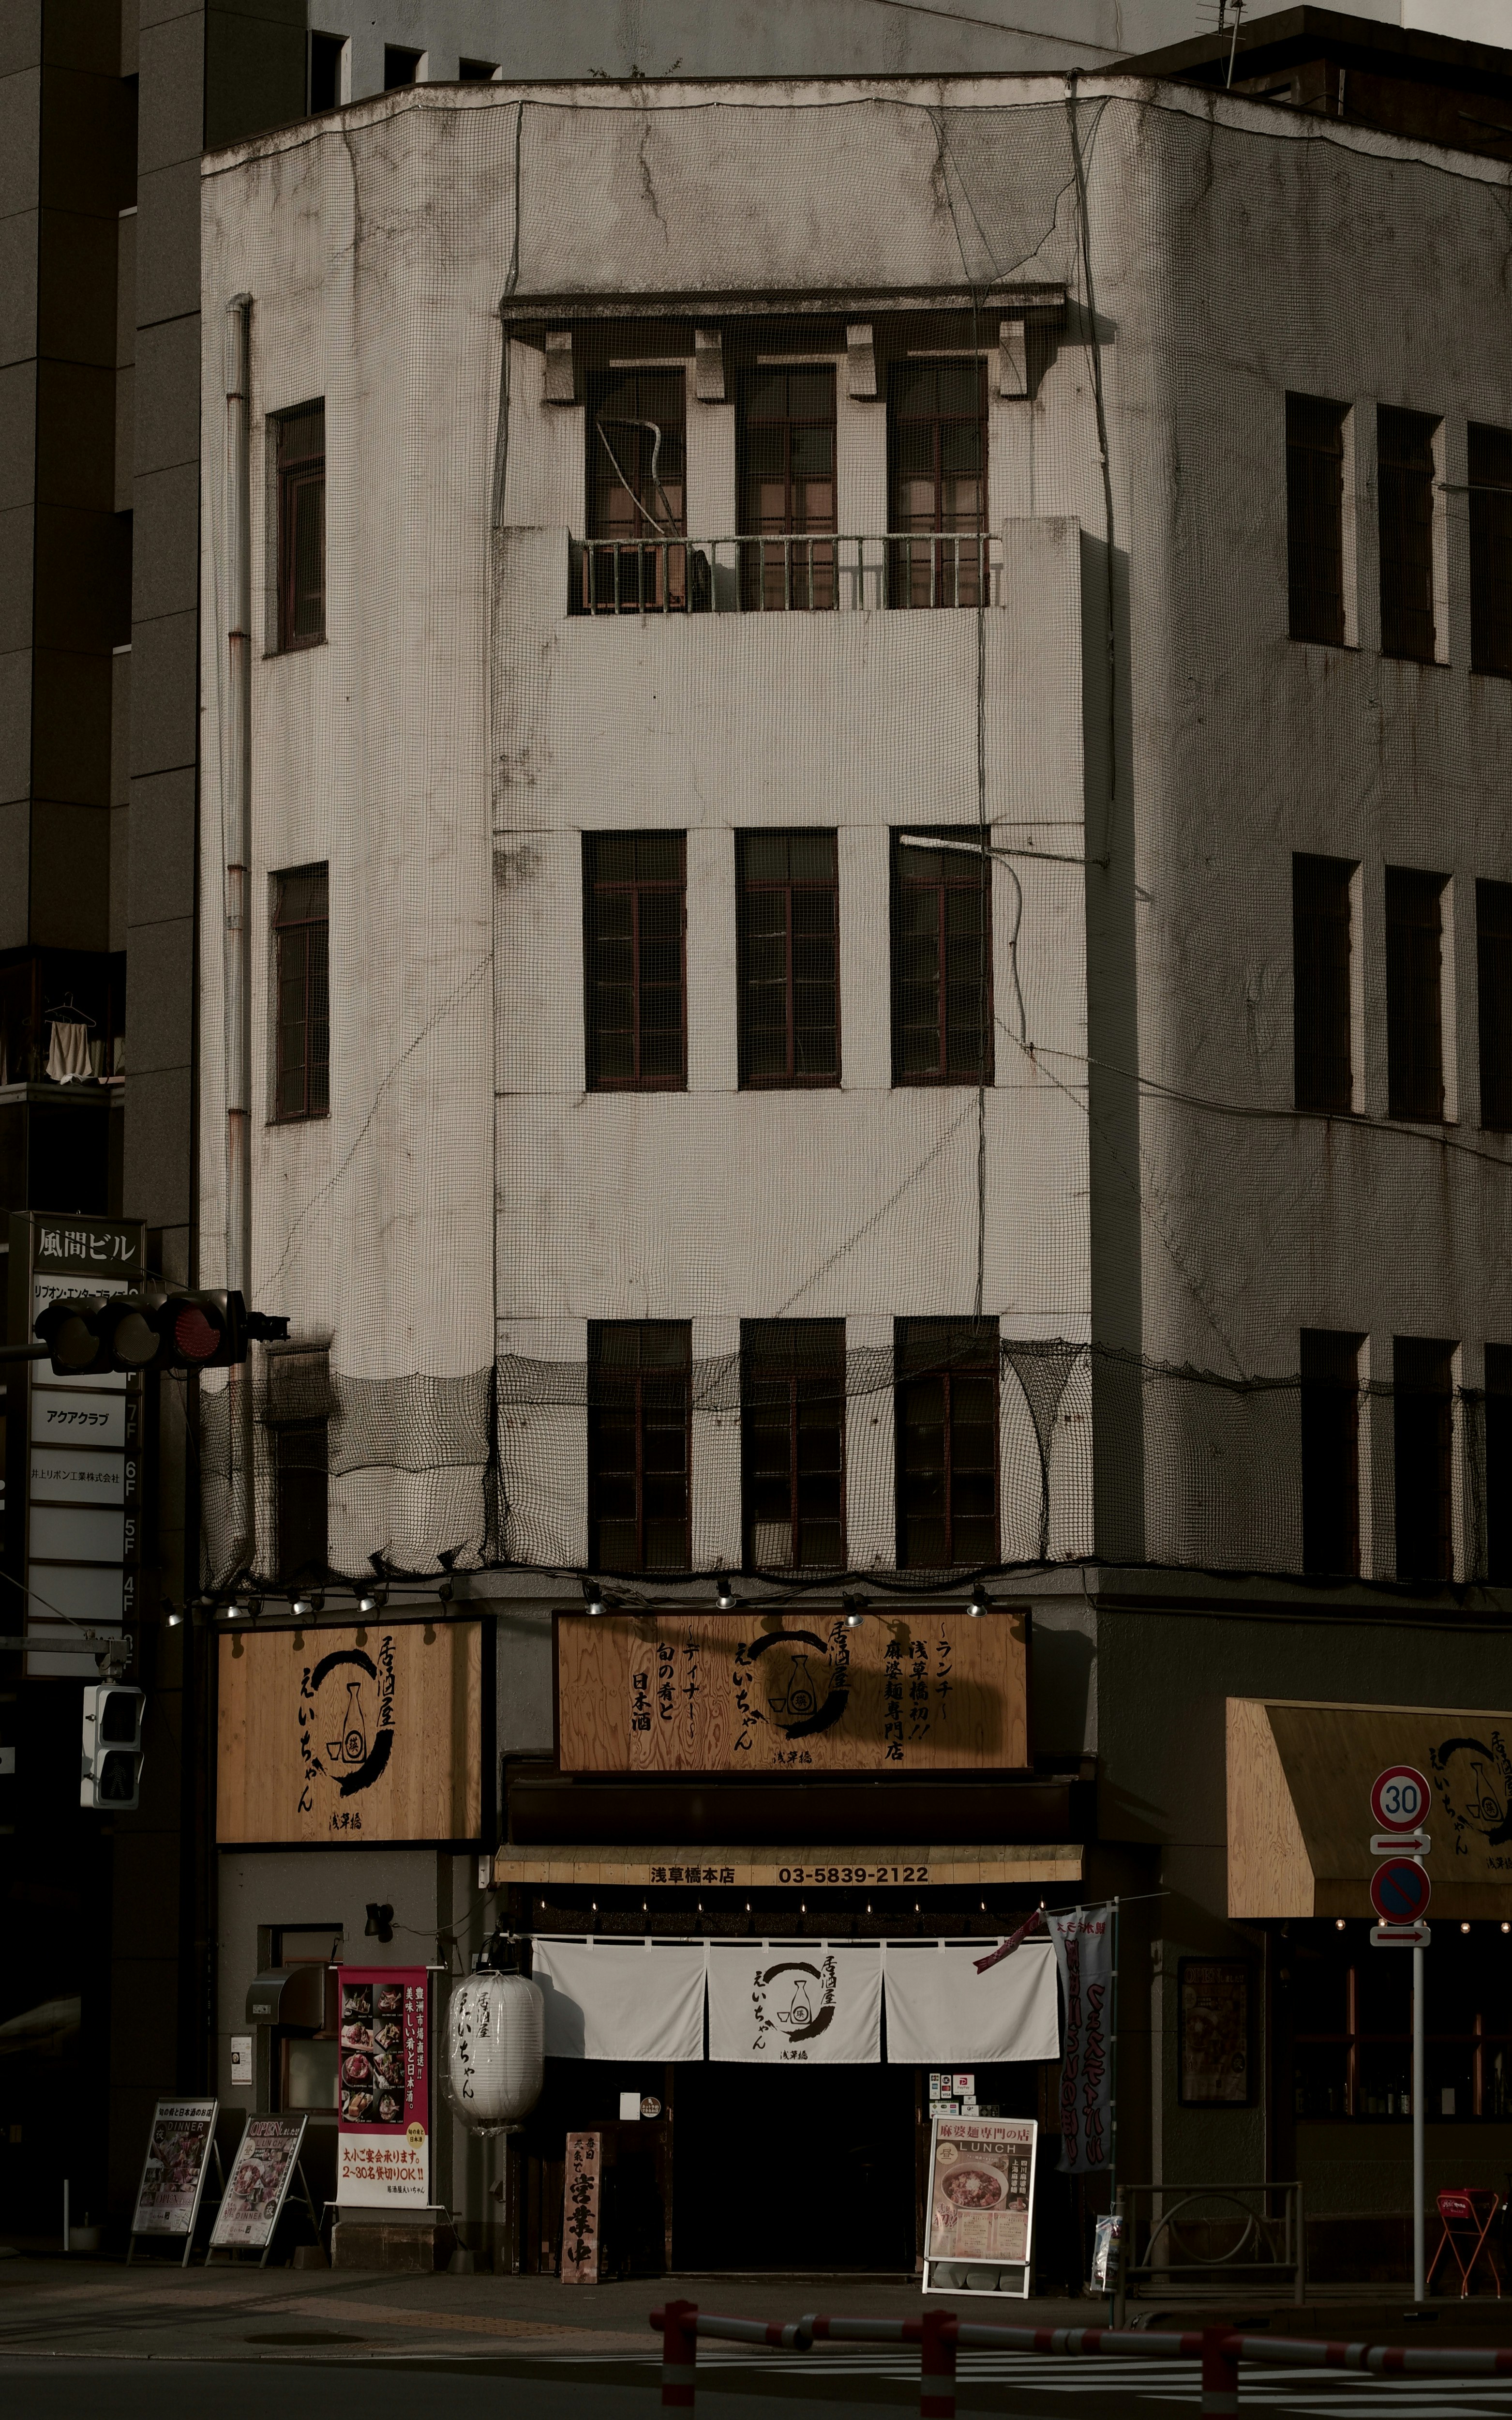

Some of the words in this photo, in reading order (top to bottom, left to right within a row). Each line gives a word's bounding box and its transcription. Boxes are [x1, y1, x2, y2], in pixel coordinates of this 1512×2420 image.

[38, 1228, 136, 1261] 風間ビル
[47, 1410, 109, 1426] アクアクラブ
[31, 1469, 120, 1483] 井上リボン工業株式会社
[126, 1461, 136, 1497] 6F
[125, 1519, 135, 1555] 5F
[124, 1576, 135, 1612] 4F
[828, 1621, 851, 1689] 居酒屋
[377, 1635, 396, 1727] 居酒屋
[657, 1643, 676, 1720] 旬の肴と
[733, 1643, 758, 1751] えいちゃん
[908, 1640, 930, 1739] 浅草橋初!!
[631, 1673, 652, 1731] 日本酒
[883, 1640, 904, 1761] 麻婆麺専門店
[298, 1667, 315, 1813] えいちゃん
[774, 1751, 813, 1765] 浅草橋
[1385, 1785, 1417, 1814] 30
[1429, 1747, 1468, 1855] えいちゃん
[651, 1867, 735, 1884] 浅草橋本店
[779, 1867, 928, 1883] 03-5839-2122
[821, 1956, 838, 2005] 居酒屋
[752, 1971, 769, 2050] えいちゃん
[405, 1986, 416, 2109] 美味しい肴と日本酒。
[415, 1986, 424, 2080] 豊洲市場直送!!
[458, 1992, 475, 2099] えいちゃん
[780, 2050, 808, 2060] 浅草橋
[159, 2107, 213, 2117] 旬の肴と日本酒のお店
[168, 2122, 204, 2132] DINNER
[940, 2125, 1030, 2142] 麻婆麺専門の店
[959, 2142, 1016, 2153] LUNCH
[343, 2148, 420, 2164] 大小ご宴会承ります。
[940, 2149, 954, 2160] 昼
[387, 2185, 425, 2194] 居酒屋えいちゃん
[566, 2174, 596, 2269] 営業中
